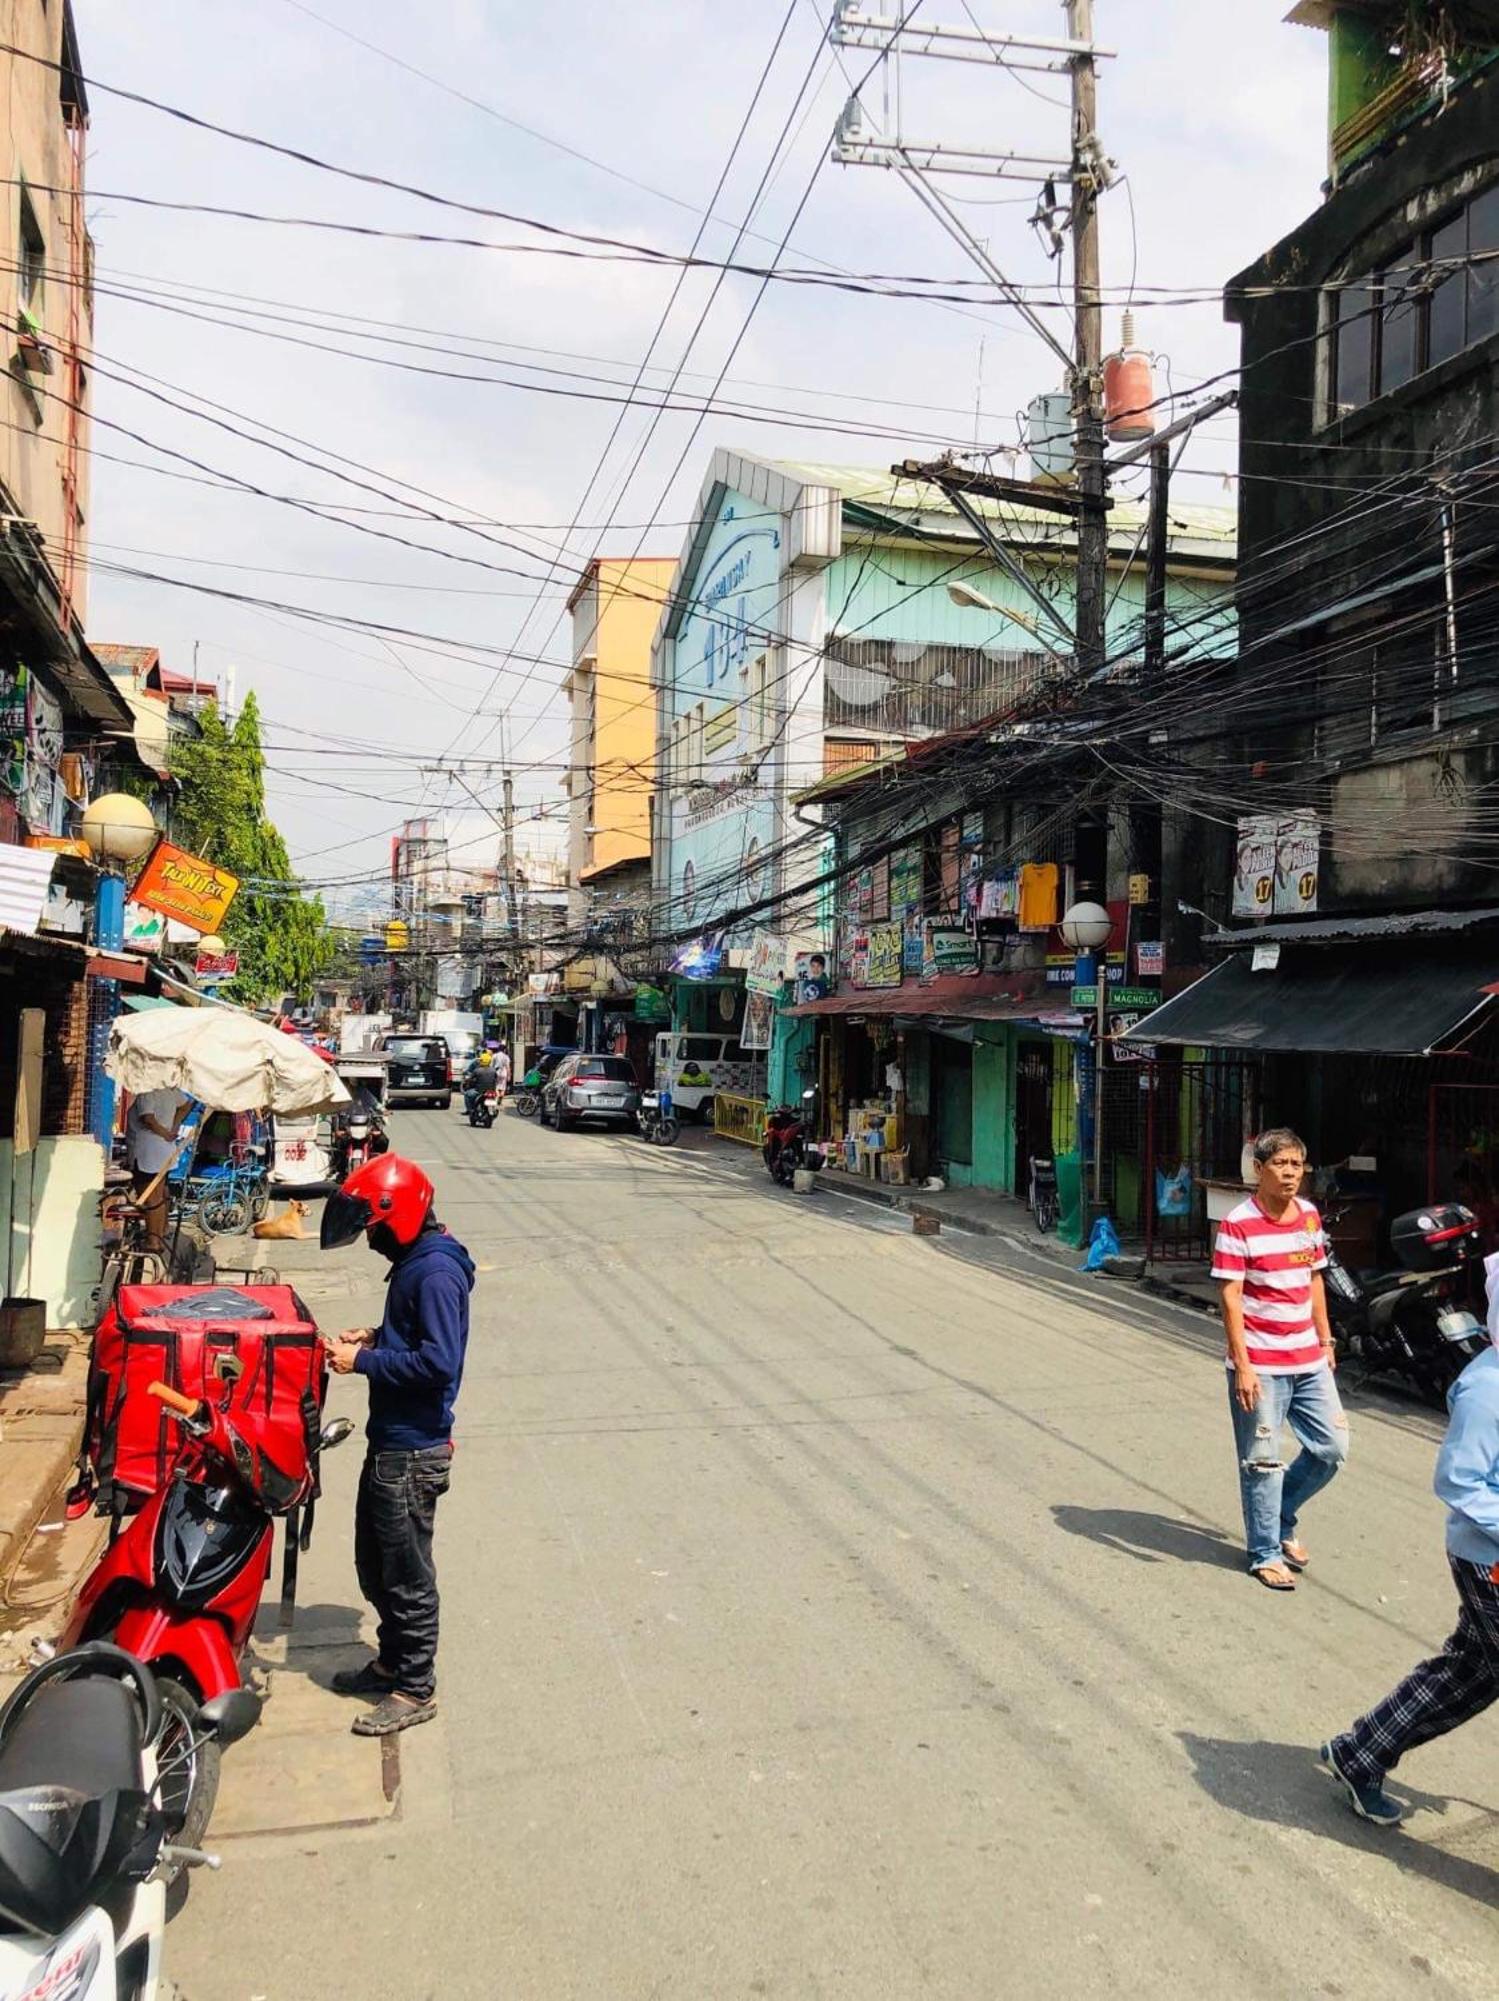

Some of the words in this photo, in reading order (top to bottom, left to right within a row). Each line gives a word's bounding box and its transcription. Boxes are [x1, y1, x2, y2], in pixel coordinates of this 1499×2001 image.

[1257, 879, 1271, 901] 17
[1301, 875, 1315, 897] 17
[1113, 994, 1159, 1006] MAGNOLIA
